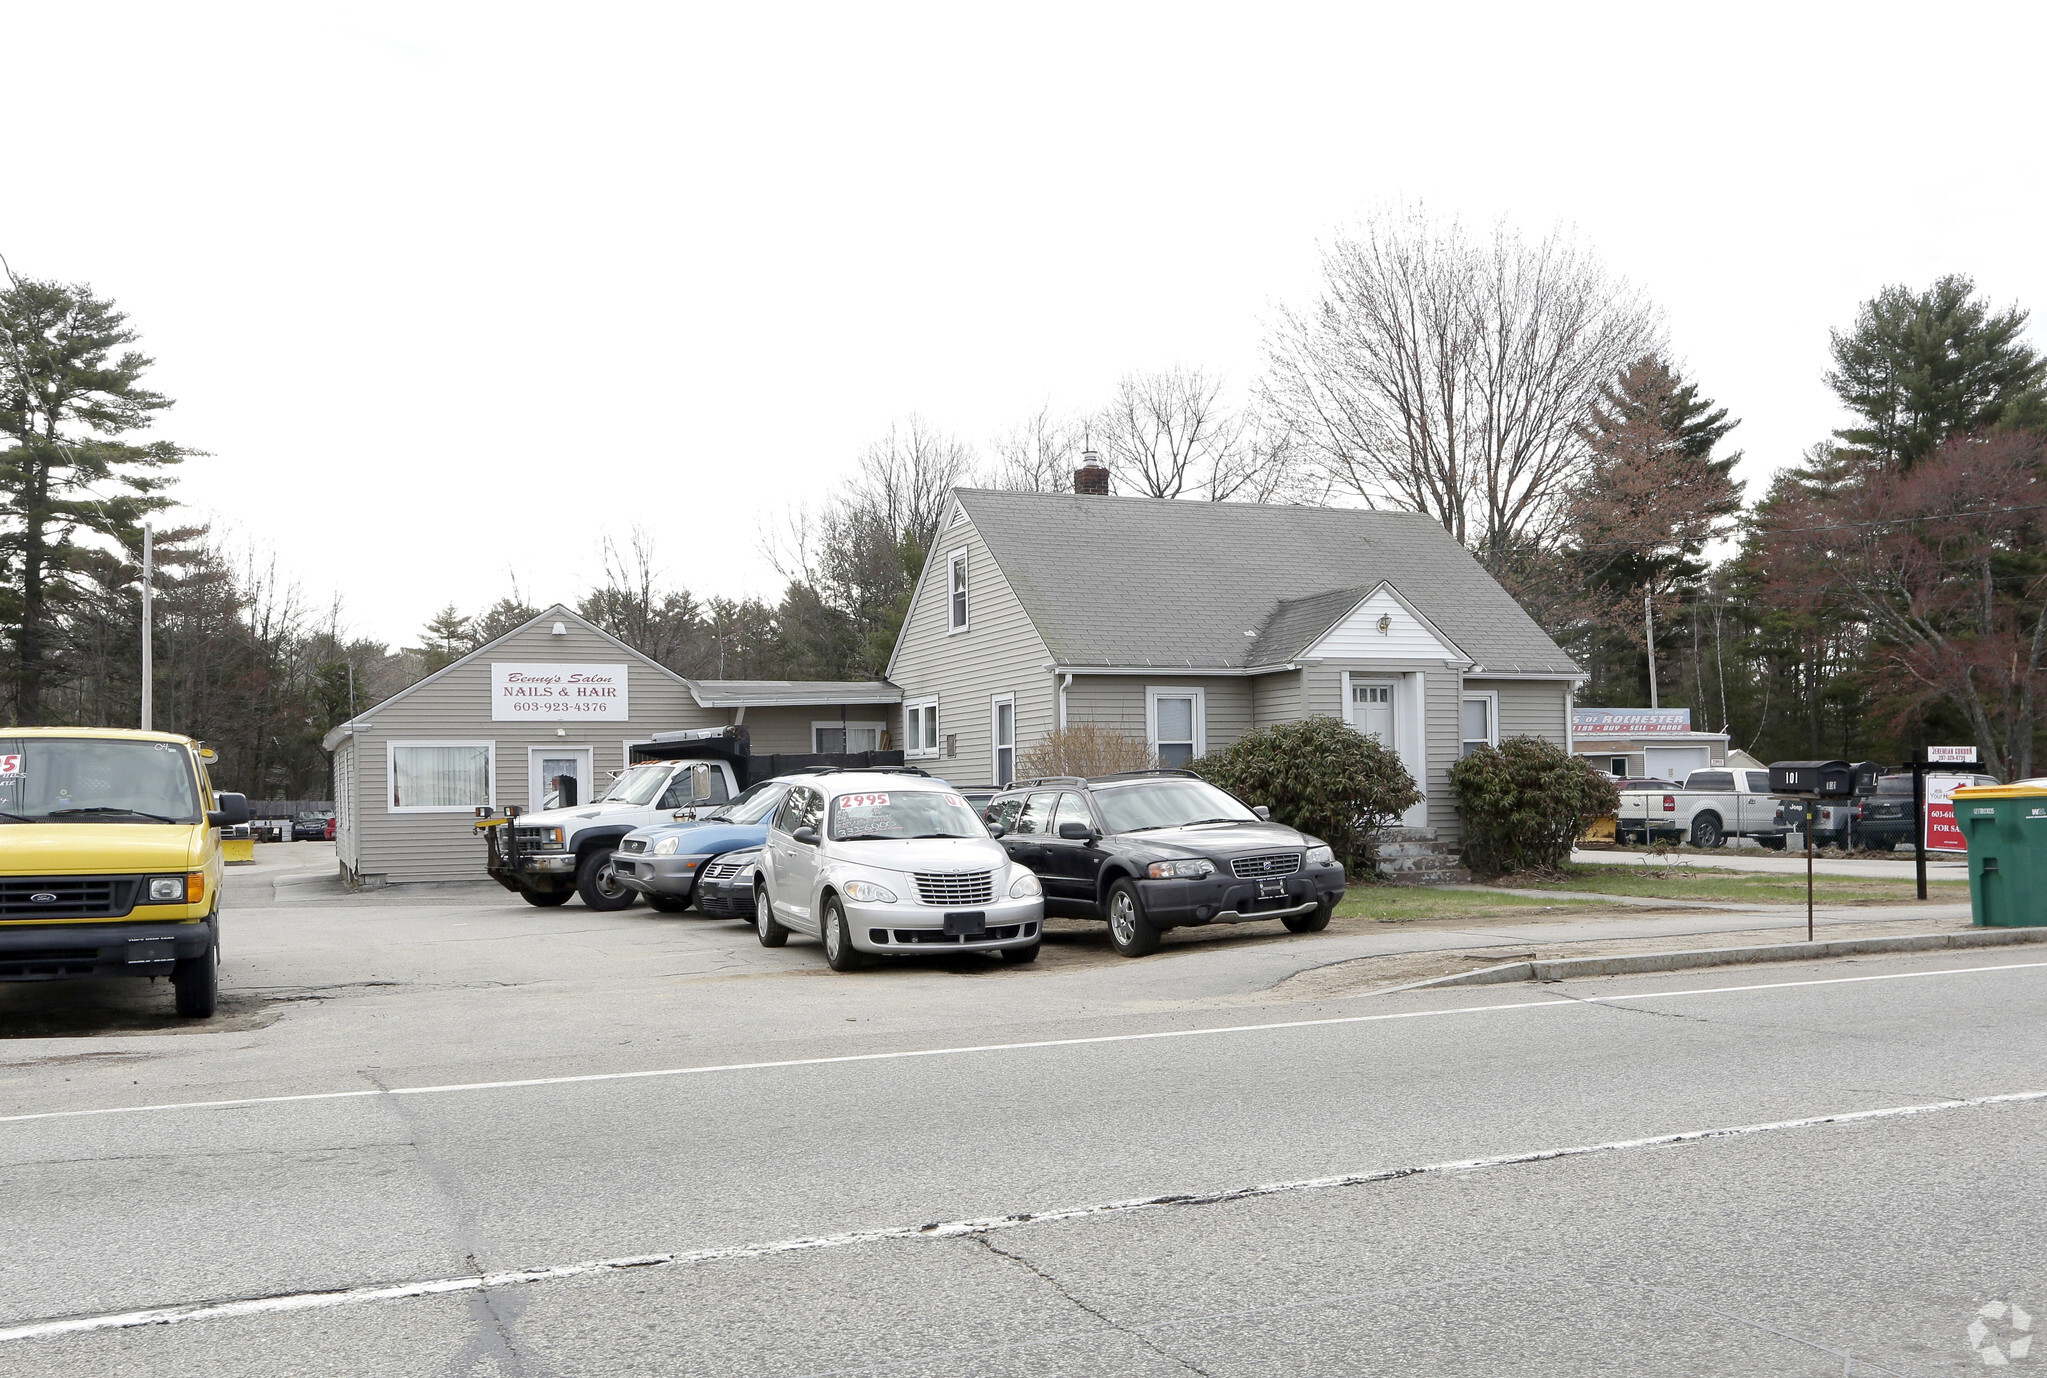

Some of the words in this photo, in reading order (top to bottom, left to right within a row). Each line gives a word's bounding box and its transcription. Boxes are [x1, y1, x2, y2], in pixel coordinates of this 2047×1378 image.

[508, 672, 561, 685] Benny's
[567, 673, 613, 684] Salon
[503, 687, 553, 698] NAILS
[558, 687, 570, 697] &
[577, 687, 617, 698] HAIR
[513, 702, 607, 713] 603-923-4376
[1602, 715, 1684, 724] ROCHESTER
[1785, 771, 1799, 784] 101
[841, 794, 888, 808] 2995
[1789, 803, 1803, 811] Jeep
[1933, 824, 1949, 832] FOR
